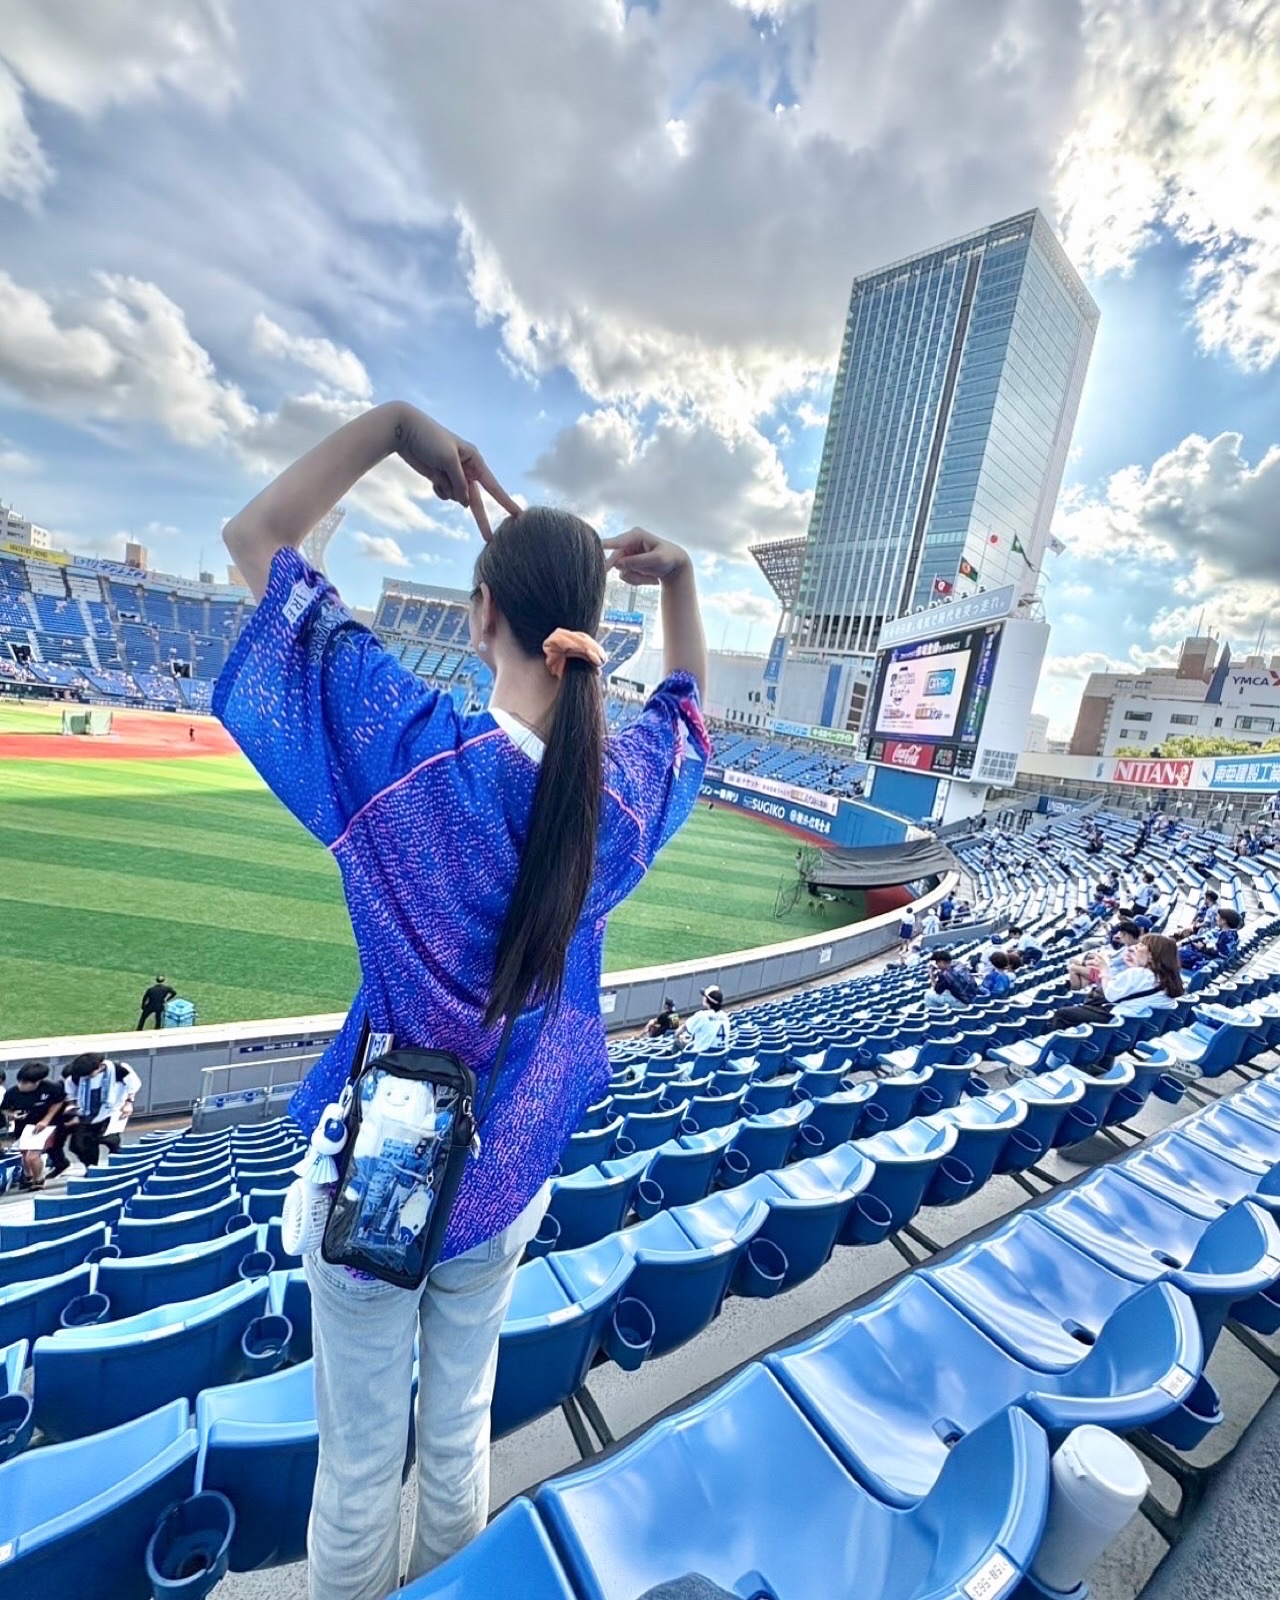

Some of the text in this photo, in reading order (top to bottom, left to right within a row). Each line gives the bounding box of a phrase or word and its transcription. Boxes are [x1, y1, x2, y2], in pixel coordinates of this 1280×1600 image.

[1233, 675, 1269, 686] YMCA
[1114, 760, 1176, 784] NITTAN
[752, 798, 785, 819] SUGIKO
[716, 1024, 726, 1041] 4
